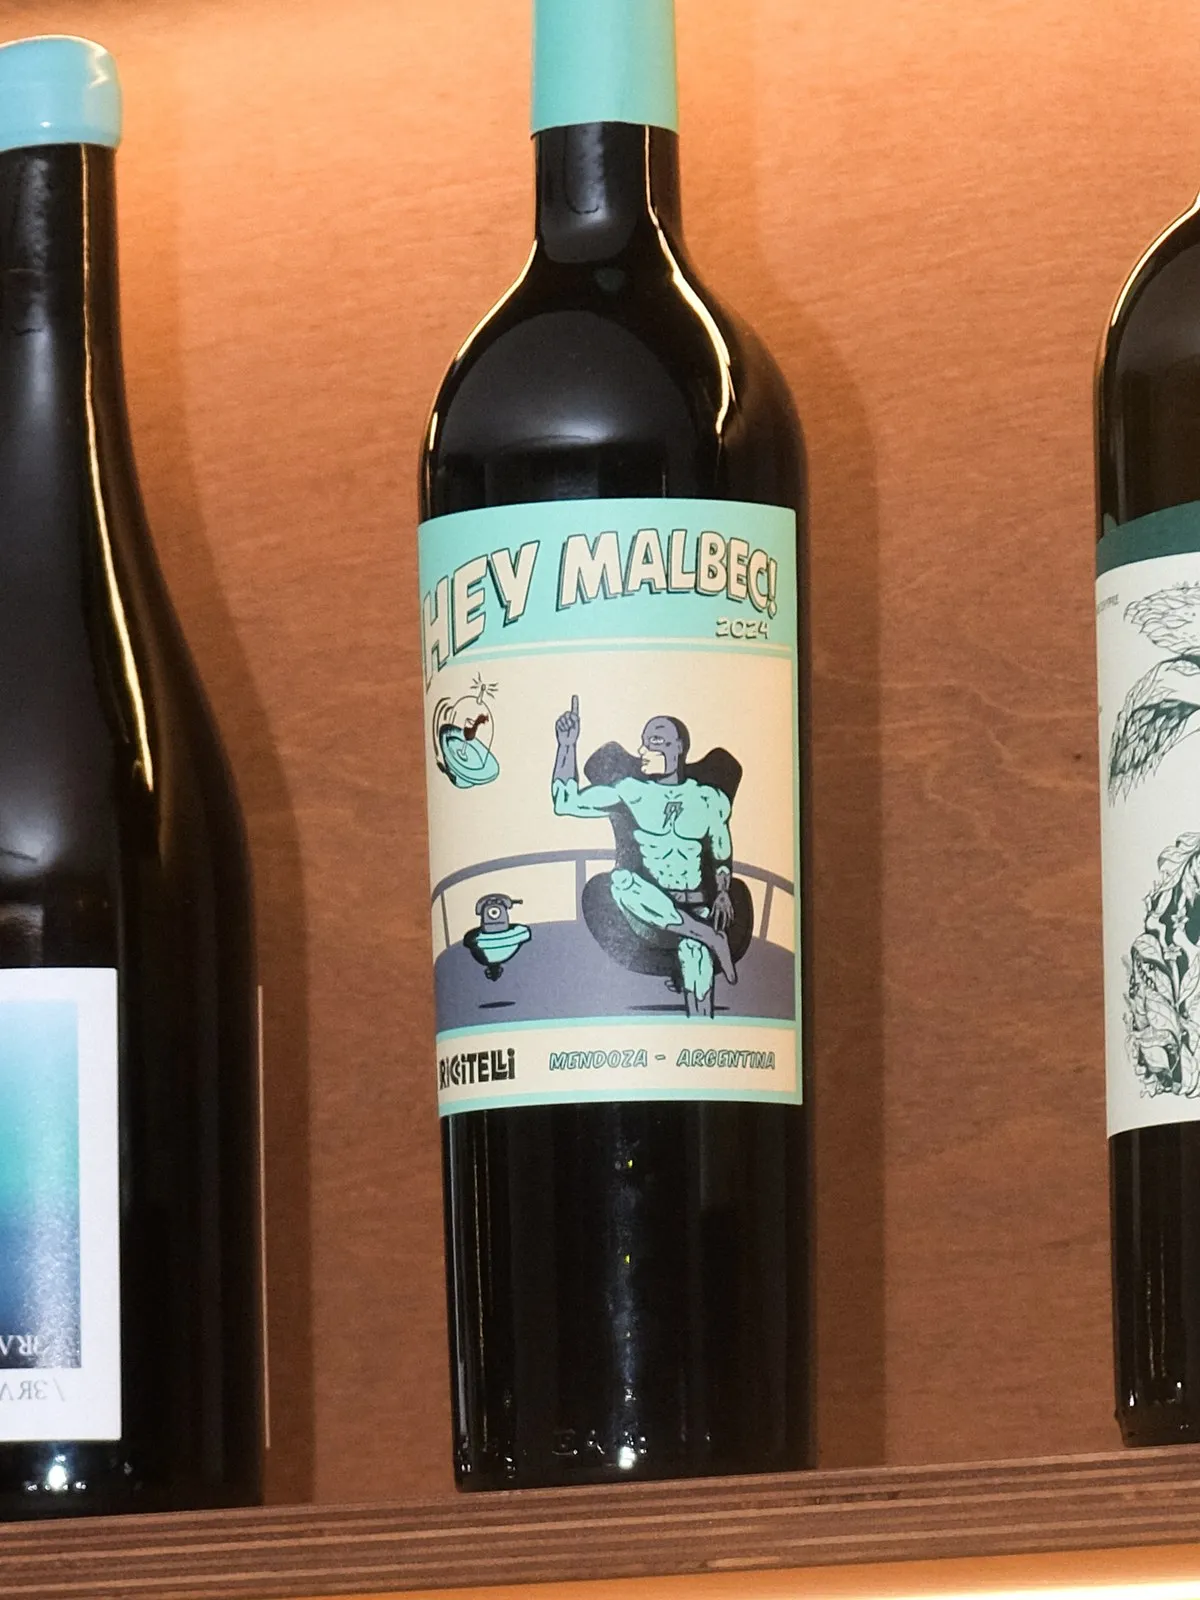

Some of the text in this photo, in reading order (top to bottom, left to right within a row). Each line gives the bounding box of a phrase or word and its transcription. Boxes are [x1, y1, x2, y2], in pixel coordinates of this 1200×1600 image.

[423, 528, 778, 690] HEY MALBEC!
[715, 616, 770, 640] 2024
[549, 1049, 648, 1071] MENDOZA
[676, 1049, 776, 1071] ARGENTINA
